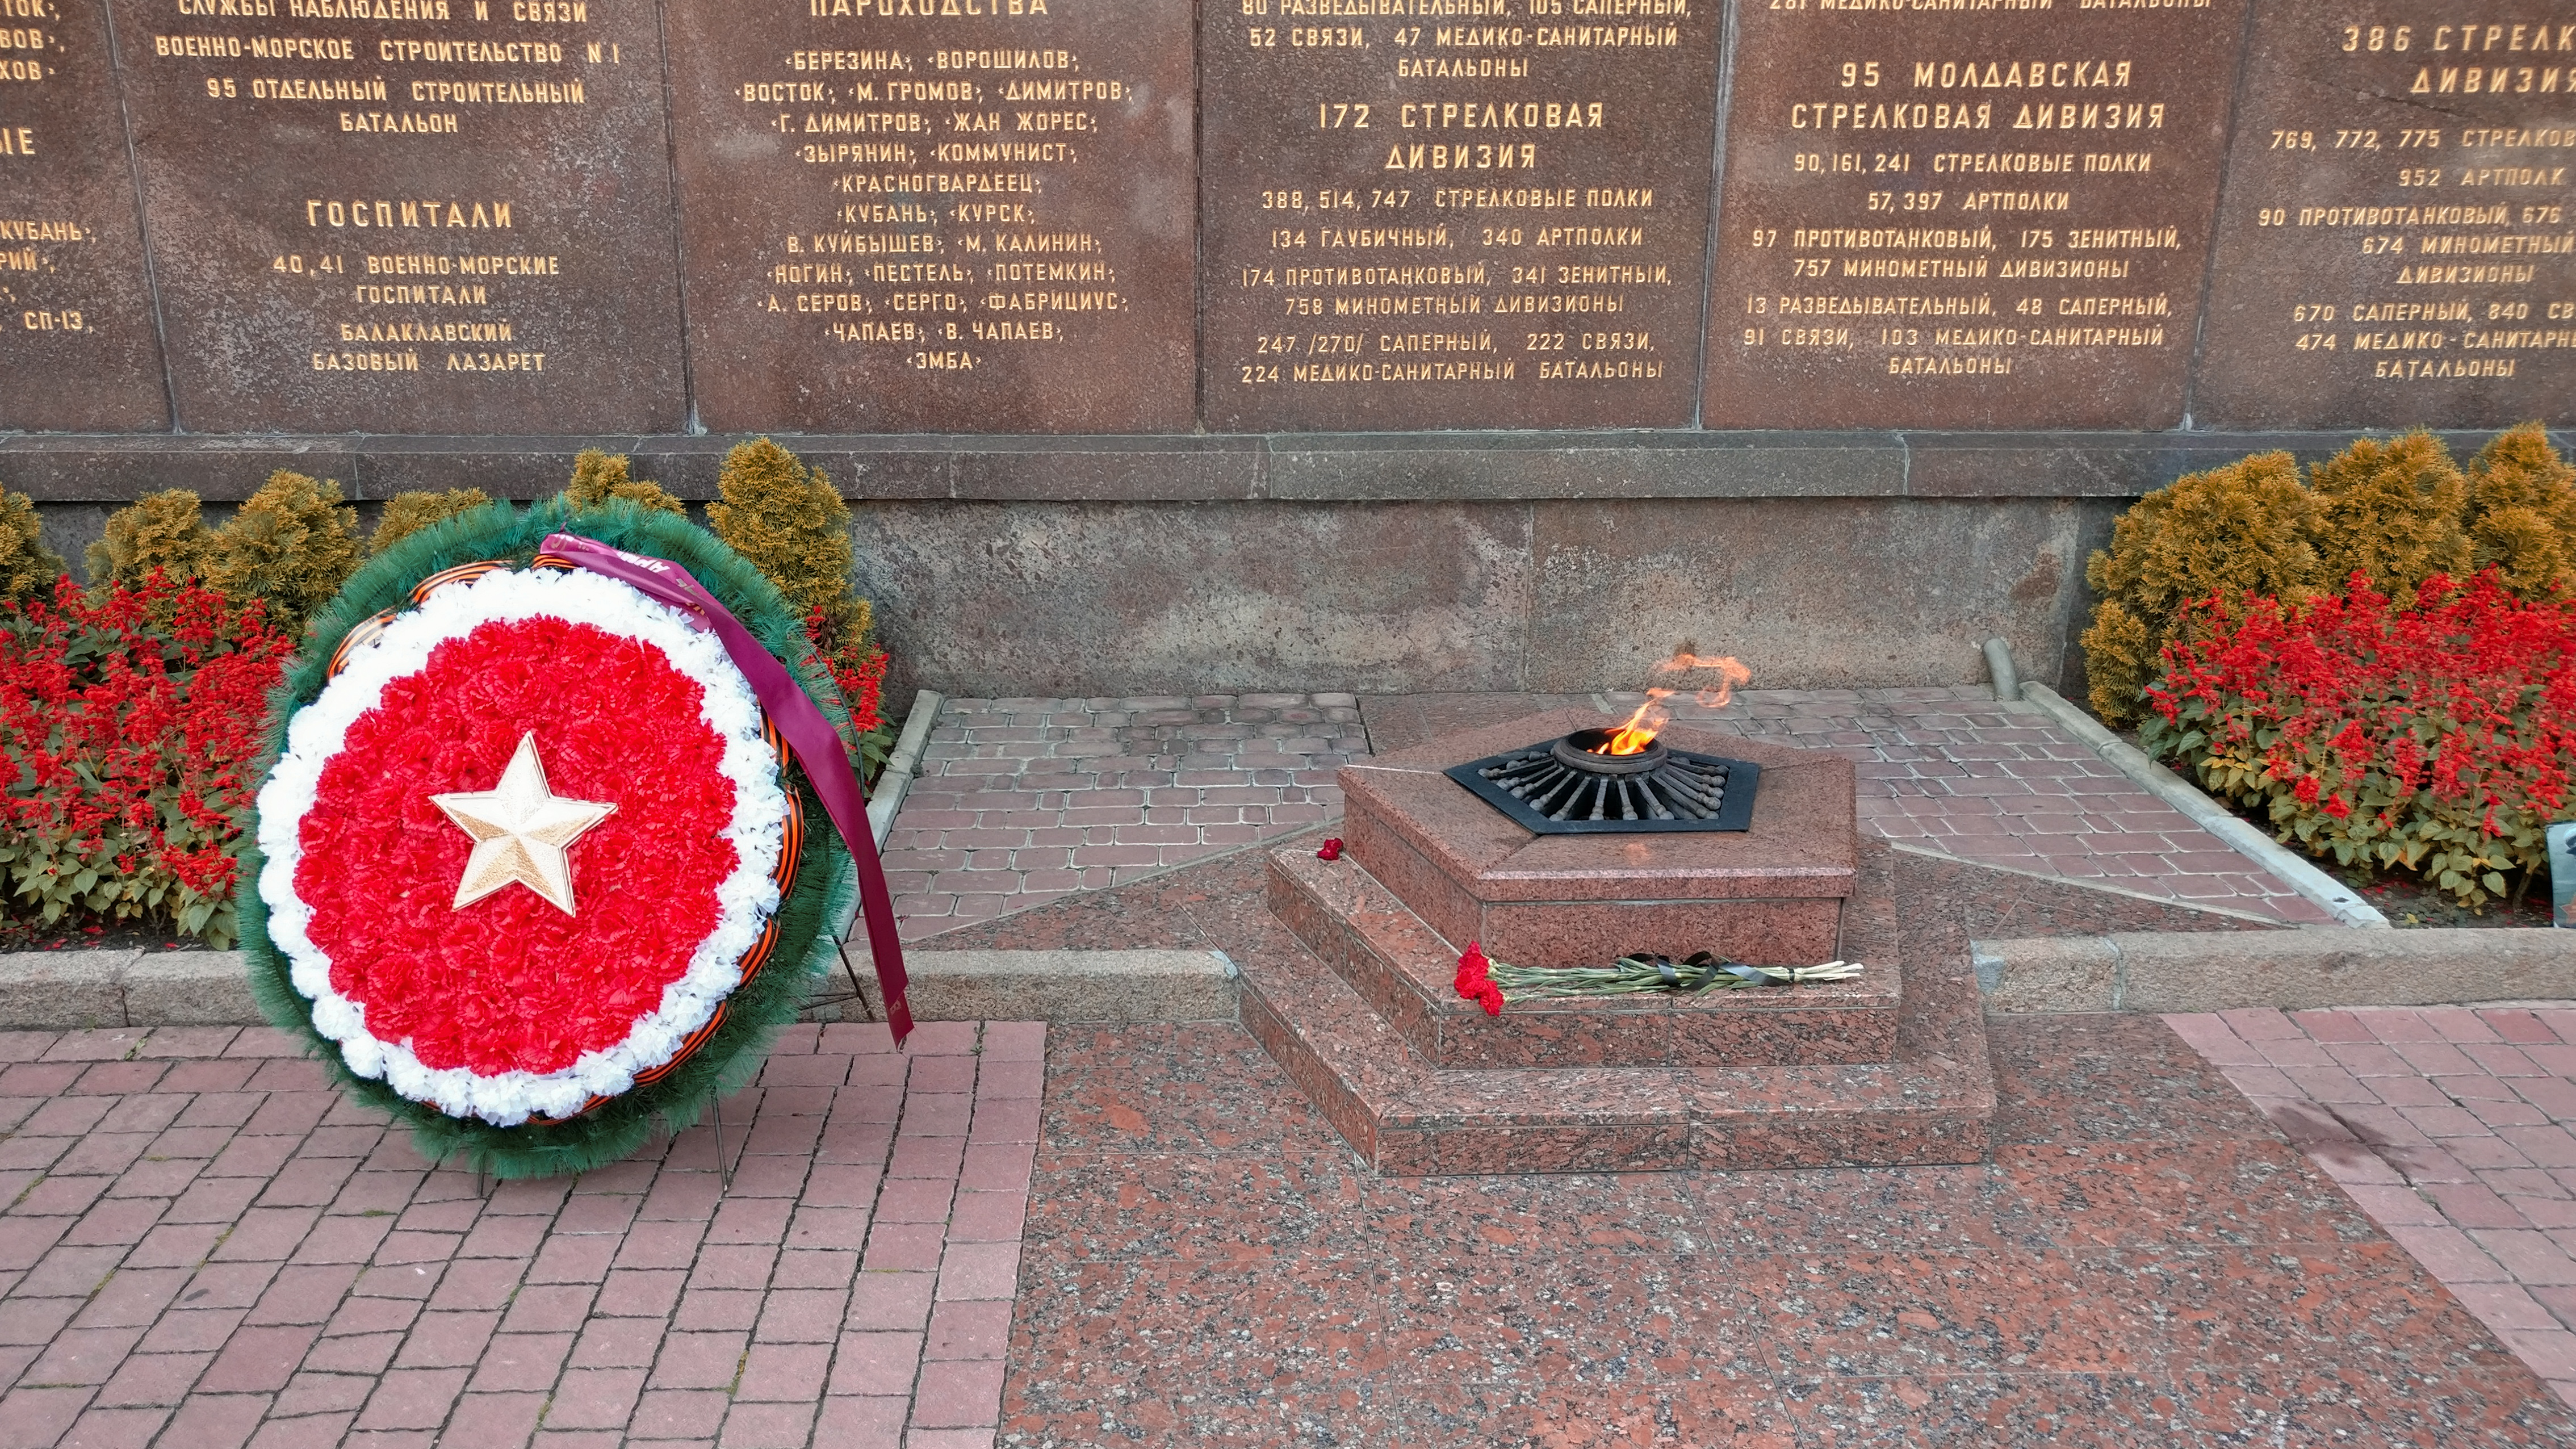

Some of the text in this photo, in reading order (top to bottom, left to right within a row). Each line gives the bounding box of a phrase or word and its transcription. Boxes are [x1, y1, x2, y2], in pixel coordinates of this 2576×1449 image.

[179, 0, 587, 22] СЛУЖБЫ НАБЛЮДЕНИЯ И СВЯЗИ
[1530, 0, 1562, 15] 105
[1250, 22, 1677, 50] 52 СВЯЗИ, 47 МЕДИКО-САНИТАРНЫЙ
[2342, 25, 2411, 51] 386
[156, 36, 354, 60] ВОЕННО-МОРСКОЕ
[380, 40, 561, 62] СТРОИТЕЛЬСТВО
[1399, 58, 1527, 77] БАТАЛЬОНЫ
[1841, 61, 2131, 87] 95 МОЛДАВСКАЯ
[207, 76, 584, 103] 95 ОТДЕЛЬНЫЙ СТРОИТЕЛЬНЫЙ
[341, 112, 458, 132] БАТАЛЬОН
[1321, 102, 1602, 128] 172 СТРЕЛКОВАЯ
[1791, 103, 2164, 129] СТРЕЛКОВАЯ ДИВИЗИЯ
[2335, 129, 2381, 151] 772,
[2399, 129, 2440, 148] 775
[1385, 144, 1535, 169] ДИВИЗИЯ
[1934, 153, 2074, 172] СТРЕЛКОВЫЕ
[2084, 153, 2151, 171] ПОЛКИ
[2399, 167, 2566, 186] 952 АРТПОЛК
[1262, 189, 1652, 211] 388, 514, 747 СТРЕЛКОВЫЕ ПОЛКИ
[1869, 192, 2070, 213] 57, 397 АРТПОЛКИ
[308, 200, 512, 228] ГОСПИТАЛИ
[2258, 209, 2285, 227] 90
[2299, 202, 2511, 227] ПРОТИВОТАНКОВЫЙ,
[1272, 223, 1642, 249] 134 ГАУБИЧНЫЙ, 340 АРТПОЛКИ
[1753, 225, 2181, 251] 97 ПРОТИВОТАНКОВЫЙ, 175 ЗЕНИТНЫЙ,
[2363, 230, 2576, 254] 674 МИНОМЕТНЫЙ
[368, 256, 559, 275] ВОЕННО-МОРСКИЕ
[1243, 269, 1274, 287] 174
[1286, 262, 1492, 287] ПРОТИВОТАНКОВЫЙ,
[1513, 267, 1545, 284] 341
[1794, 256, 2129, 278] 757 МИНОМЕТНЫЙ ДИВИЗИОНЫ
[2396, 265, 2535, 284] ДИВИЗИОНЫ
[357, 285, 486, 305] ГОСПИТАЛИ
[1286, 299, 1323, 316] 758
[1495, 295, 1623, 312] ДИВИЗИОНЫ
[1748, 292, 2172, 317] 13 РАЗВЕДЫВАТЕЛЬНЫЙ, 48 САПЕРНЫЙ,
[2294, 300, 2576, 323] 670 САПЕРНЫЙ, 840 СВ
[341, 319, 512, 341] БАЛАКЛАВСКИЙ
[1258, 329, 1654, 354] 247 /270/ САПЕРНЫЙ, 222 СВЯЗИ,
[1744, 324, 2163, 351] 91 СВЯЗИ, 103 МЕДИКО-САНИТАРНЫЙ
[2296, 334, 2336, 351] 474
[313, 348, 546, 371] БАЗОВЫЙ ЛАЗАРЕТ
[1242, 358, 1664, 383] 224 МЕДИКО-САНИТАРНЫЙ БАТАЛЬОНЫ
[1888, 358, 2010, 374] БАТАЛЬОНЫ
[2376, 359, 2516, 378] БАТАЛЬОНЫ
